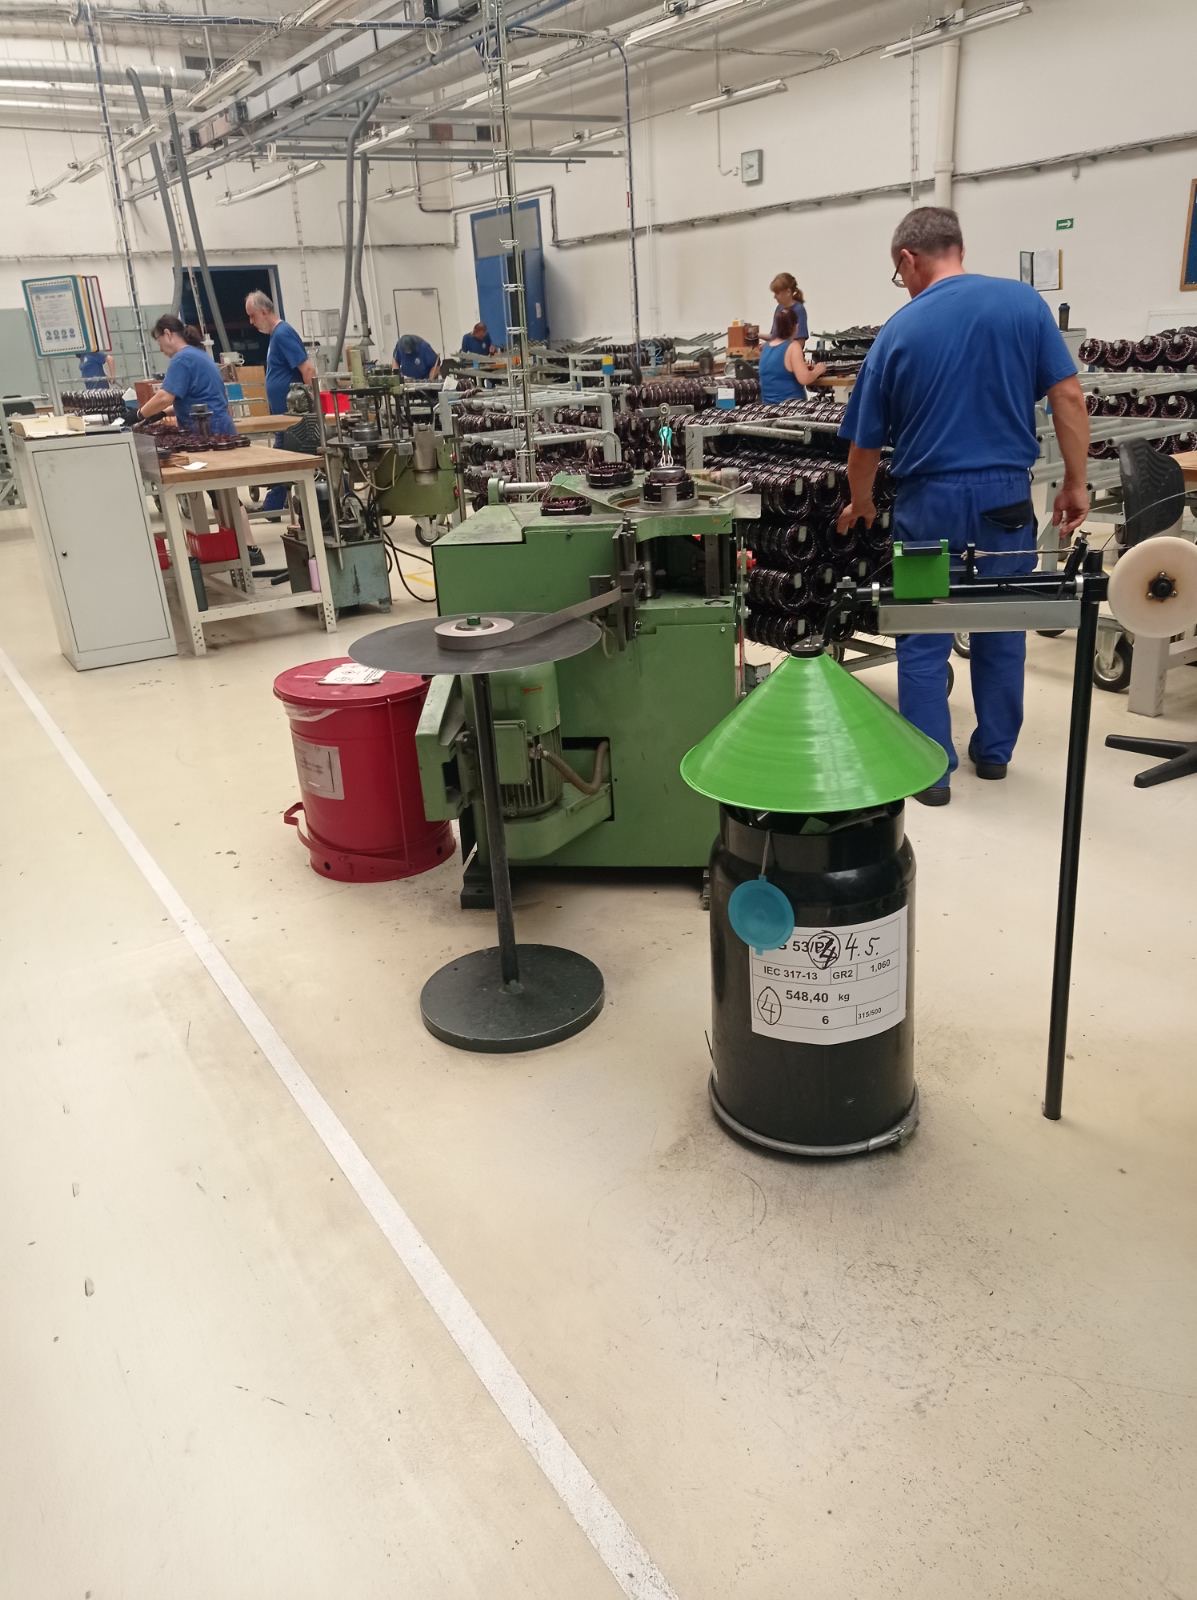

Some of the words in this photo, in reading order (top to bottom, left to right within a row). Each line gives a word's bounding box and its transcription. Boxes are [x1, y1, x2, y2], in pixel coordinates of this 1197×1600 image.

[763, 965, 781, 976] IEC
[783, 969, 818, 980] 317-13
[870, 958, 891, 973] 1,060
[832, 969, 854, 980] GR2
[785, 989, 829, 1004] 548,40
[838, 992, 850, 1002] kg
[821, 1015, 830, 1025] 6
